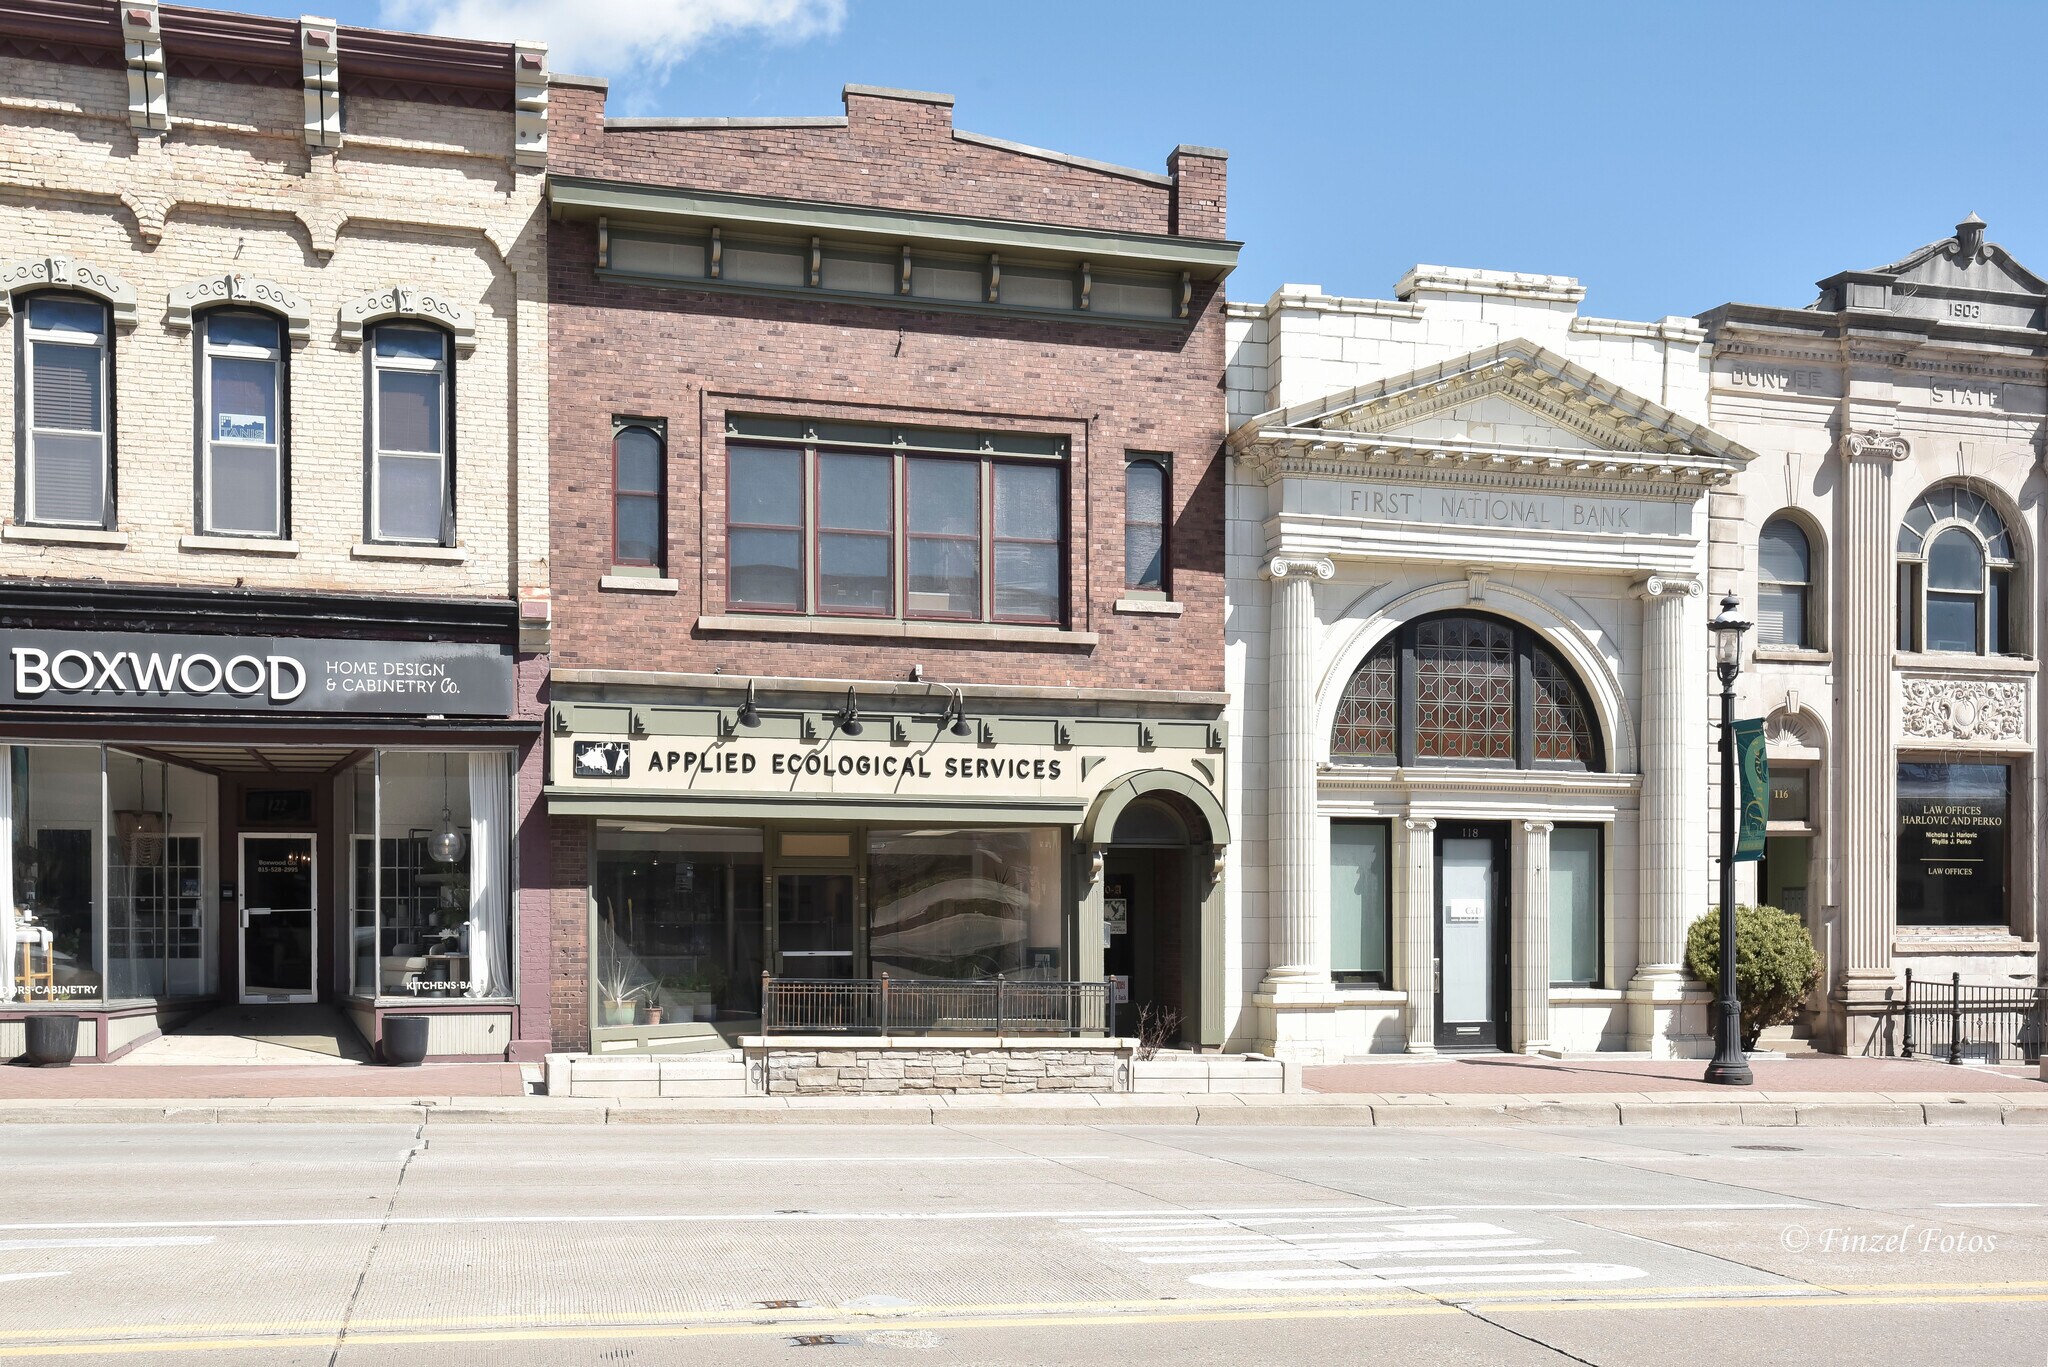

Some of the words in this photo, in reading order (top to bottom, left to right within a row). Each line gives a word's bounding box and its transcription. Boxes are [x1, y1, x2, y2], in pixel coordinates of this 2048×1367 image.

[1949, 303, 1980, 318] 1903
[1731, 363, 1823, 389] DUNDEE
[1932, 382, 2002, 406] STATE
[1351, 490, 1414, 514] FIRST
[1441, 495, 1551, 523] NATIONAL
[1573, 503, 1630, 528] BANK
[11, 647, 307, 700] BOXWOOD
[326, 661, 378, 675] HOME
[383, 662, 445, 676] DESIGN
[326, 678, 337, 691] &
[342, 678, 437, 693] CABINETRY
[440, 677, 461, 694] Co.
[648, 751, 757, 774] APPLIED
[772, 753, 932, 779] ECOLOGICAL
[944, 758, 1062, 780] SERVICES
[1774, 790, 1789, 799] 116
[1923, 806, 1943, 814] LAW
[1945, 806, 1981, 815] OFFICES
[1902, 815, 1949, 825] HARLOVIC
[1951, 817, 1970, 825] AND
[1973, 817, 2002, 826] PERKO
[1462, 828, 1479, 838] 118
